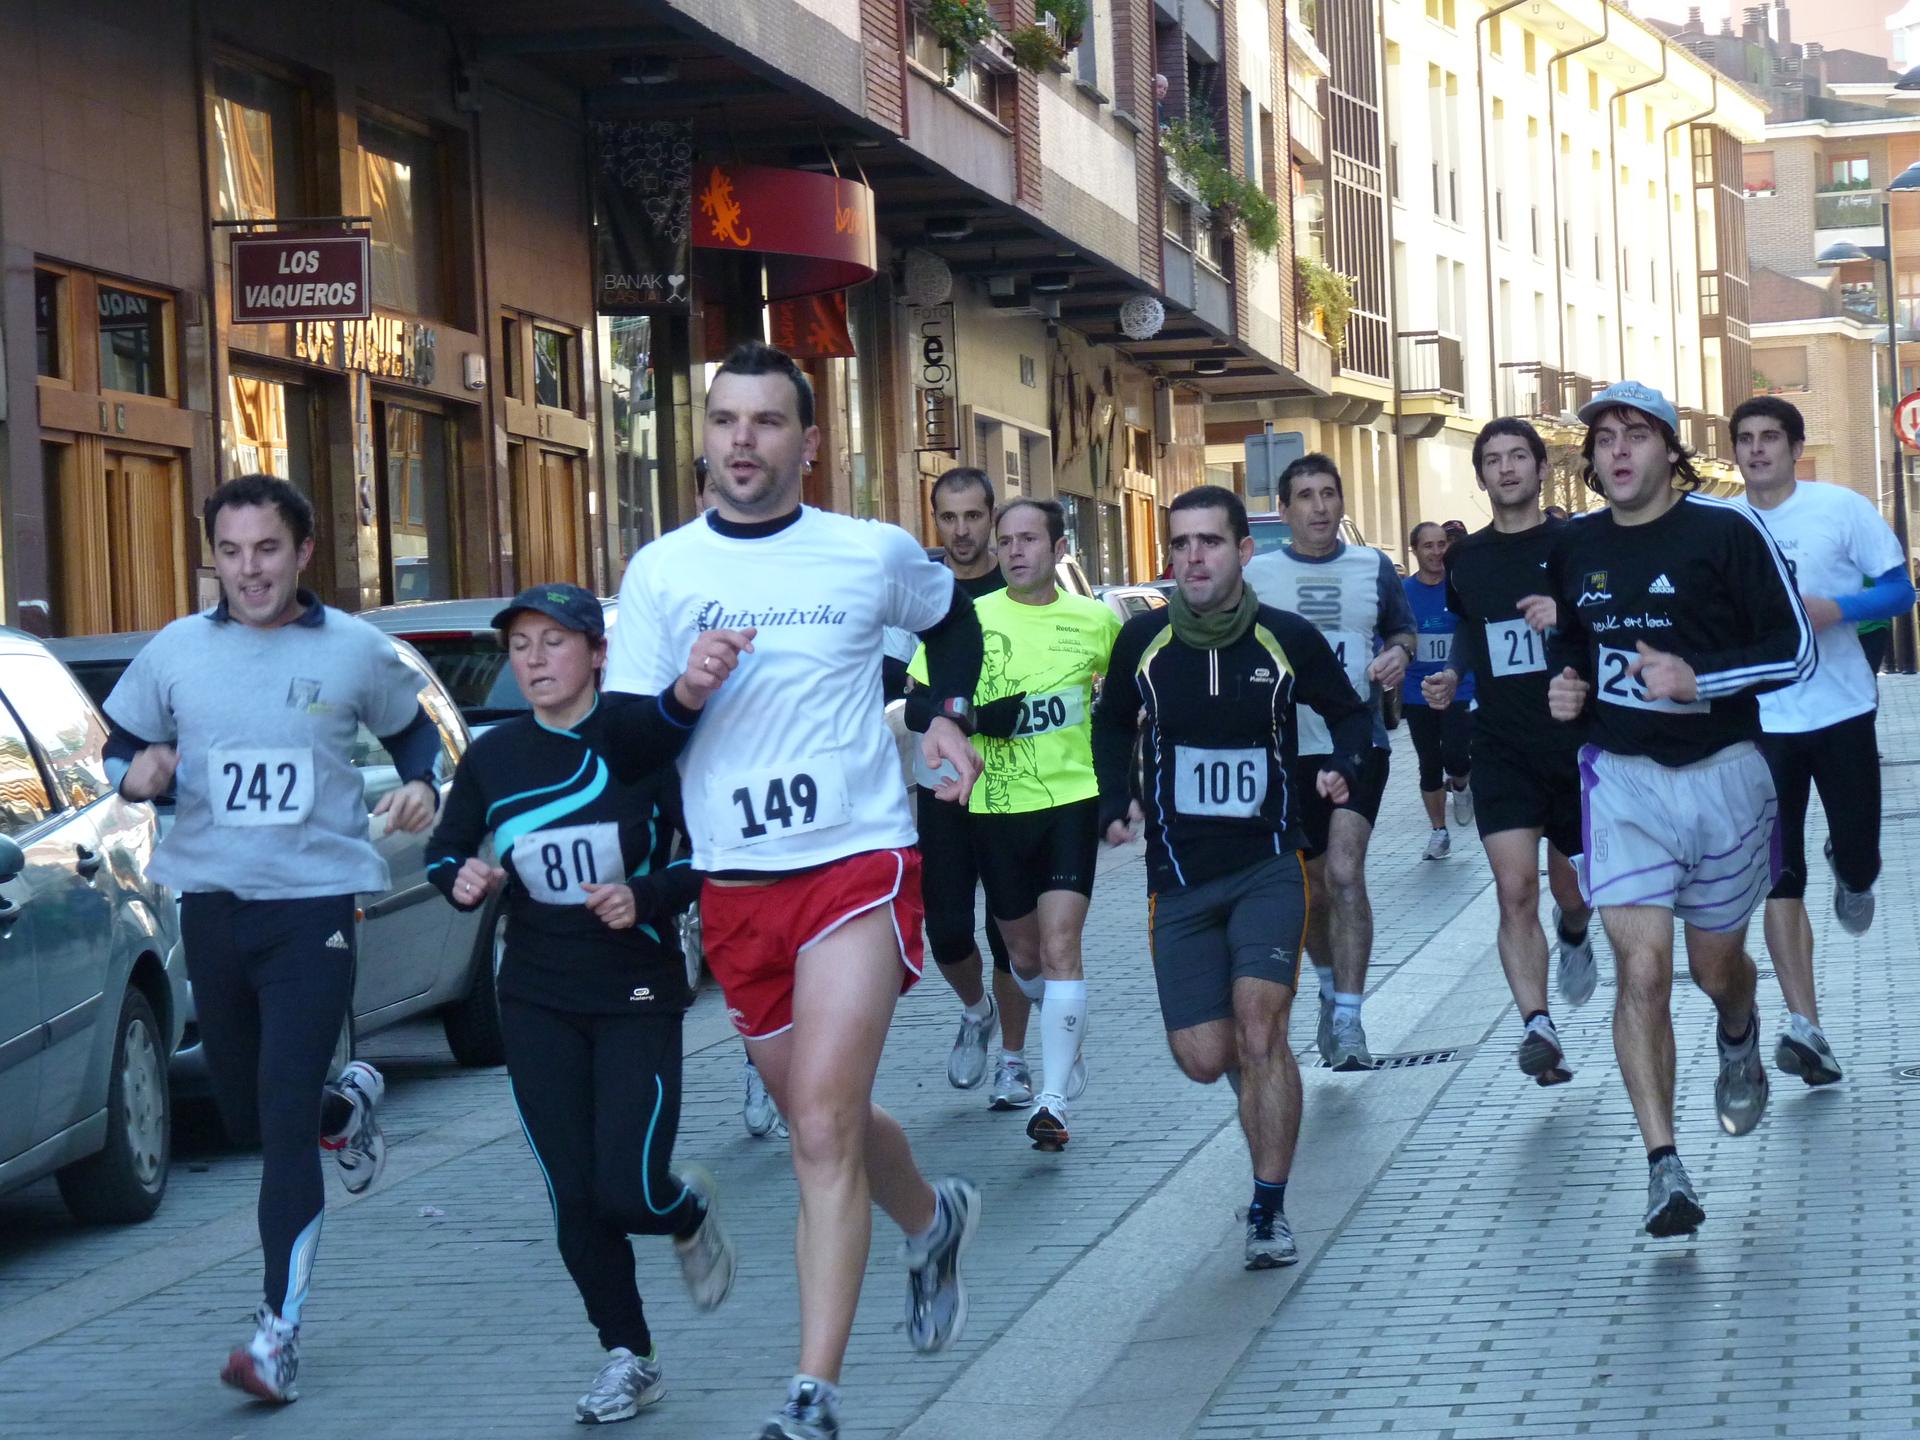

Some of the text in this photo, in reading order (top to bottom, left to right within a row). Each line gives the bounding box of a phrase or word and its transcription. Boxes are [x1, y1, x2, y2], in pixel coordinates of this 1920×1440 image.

[278, 250, 320, 274] LOS
[245, 282, 357, 308] VAQUEROS
[604, 274, 664, 291] BANAK
[913, 308, 950, 320] FOTO
[920, 320, 952, 447] imagen
[1648, 585, 1676, 594] adidas
[1055, 624, 1081, 633] Reebok
[1016, 695, 1066, 735] 250
[223, 762, 300, 812] 242
[1193, 760, 1257, 804] 106
[732, 773, 819, 840] 149
[541, 838, 598, 892] 80
